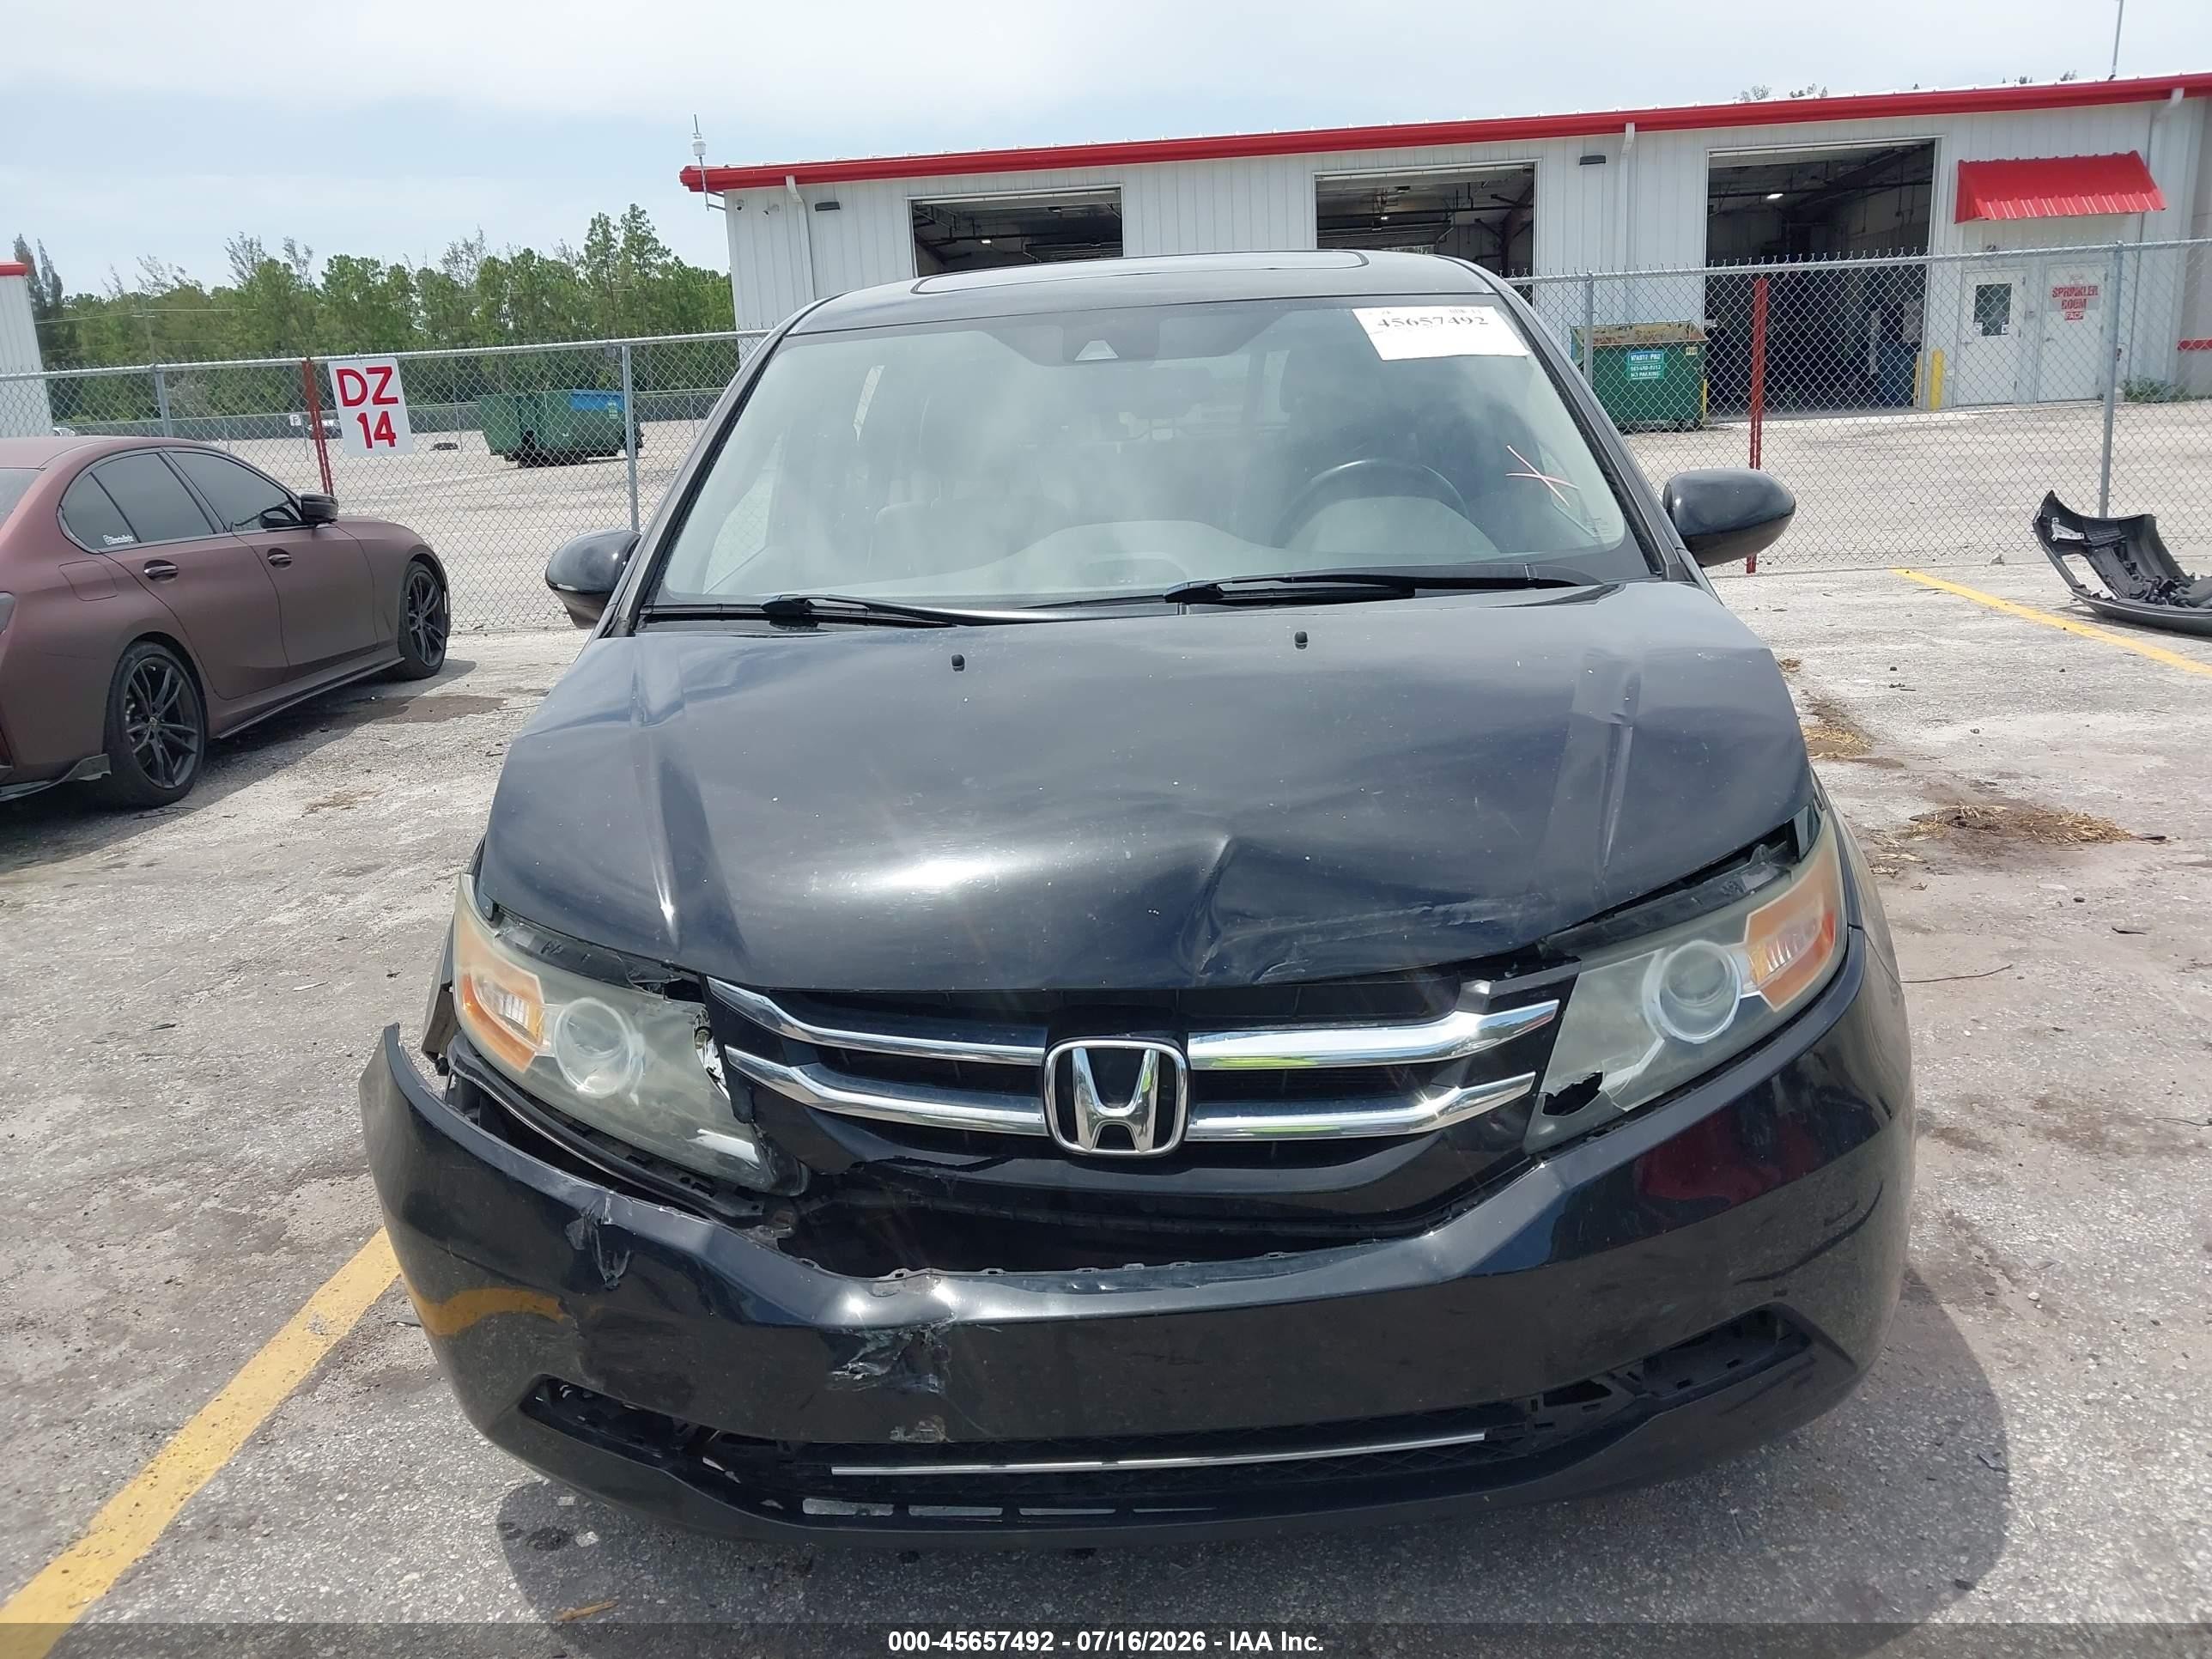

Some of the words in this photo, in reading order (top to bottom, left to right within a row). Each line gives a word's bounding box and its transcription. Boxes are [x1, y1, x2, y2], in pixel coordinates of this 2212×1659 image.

[1377, 316, 1489, 327] 45657492
[336, 366, 398, 407] DZ
[356, 410, 398, 449] 14
